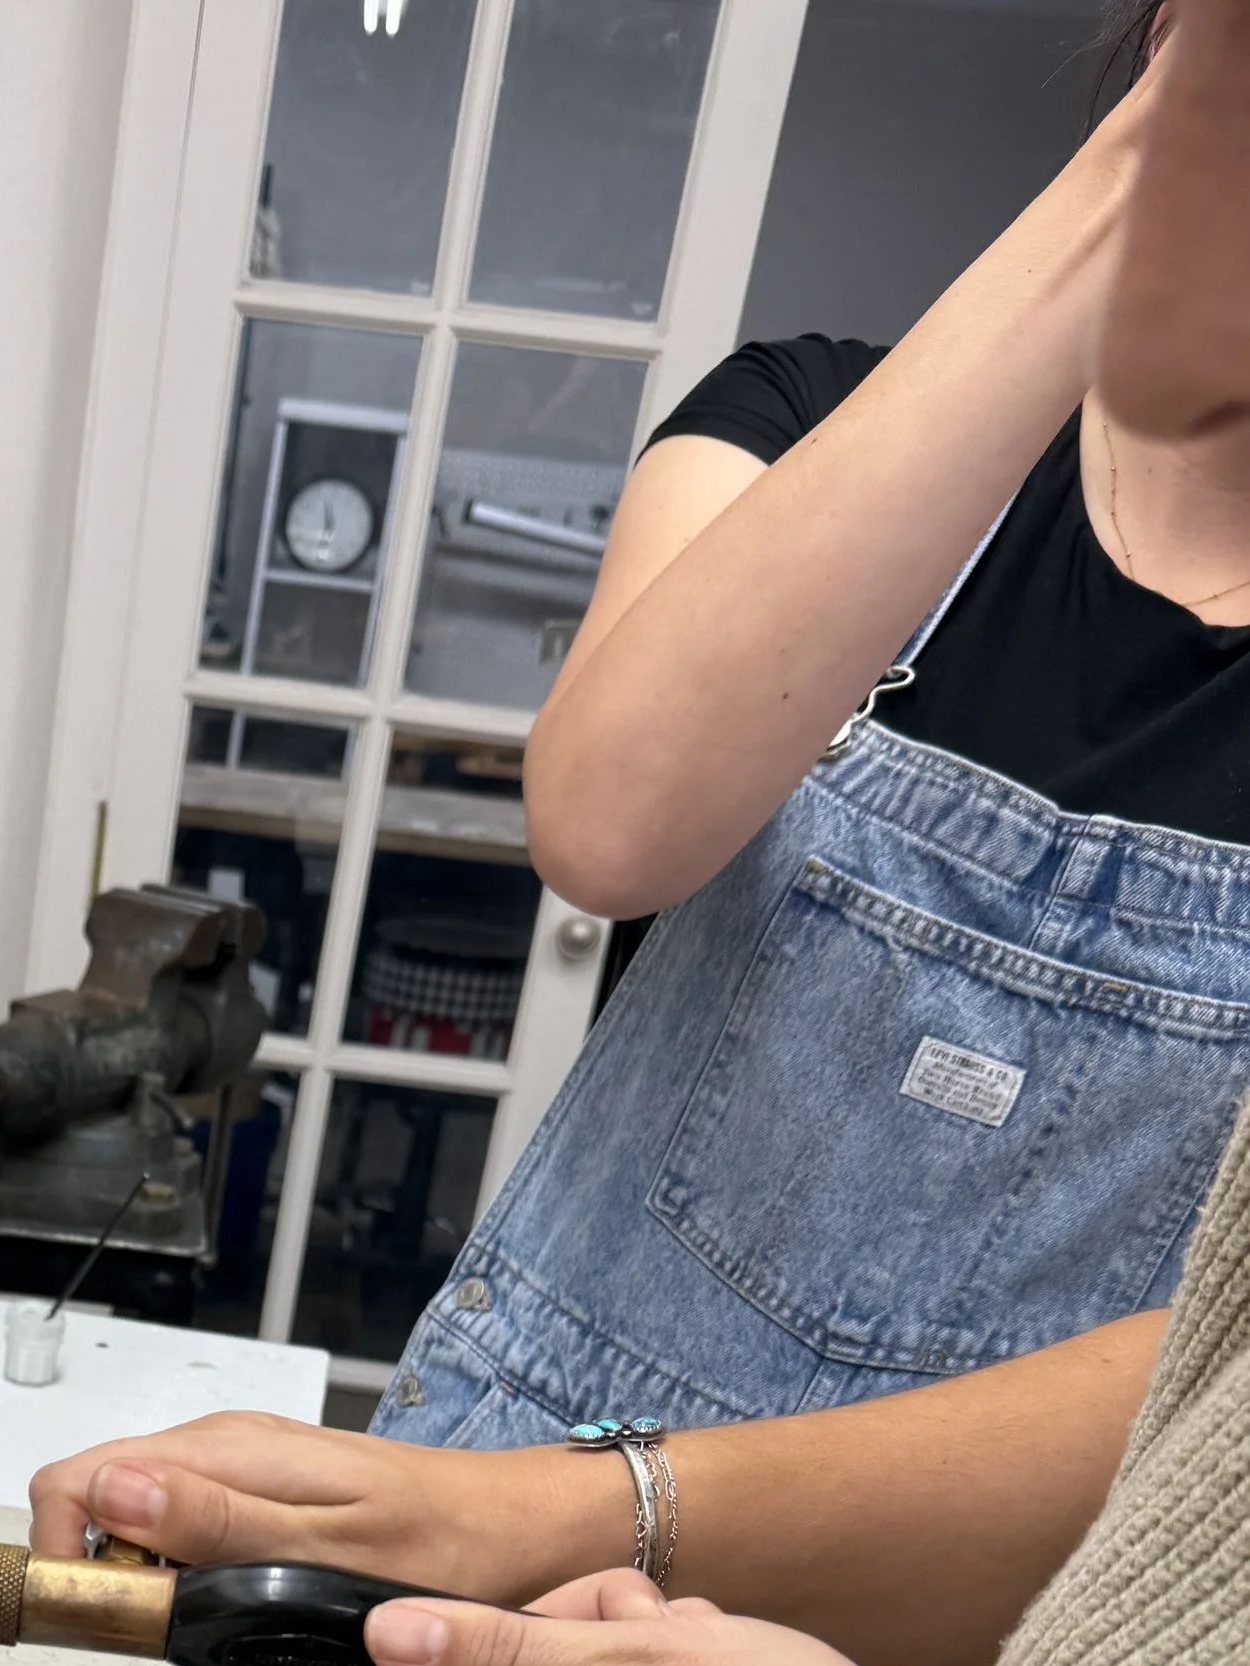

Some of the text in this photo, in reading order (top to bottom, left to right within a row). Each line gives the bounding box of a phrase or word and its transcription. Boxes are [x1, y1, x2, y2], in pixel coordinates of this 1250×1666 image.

[931, 1048, 948, 1060] LEVI
[950, 1054, 986, 1074] STRAUSS
[986, 1068, 993, 1076] &
